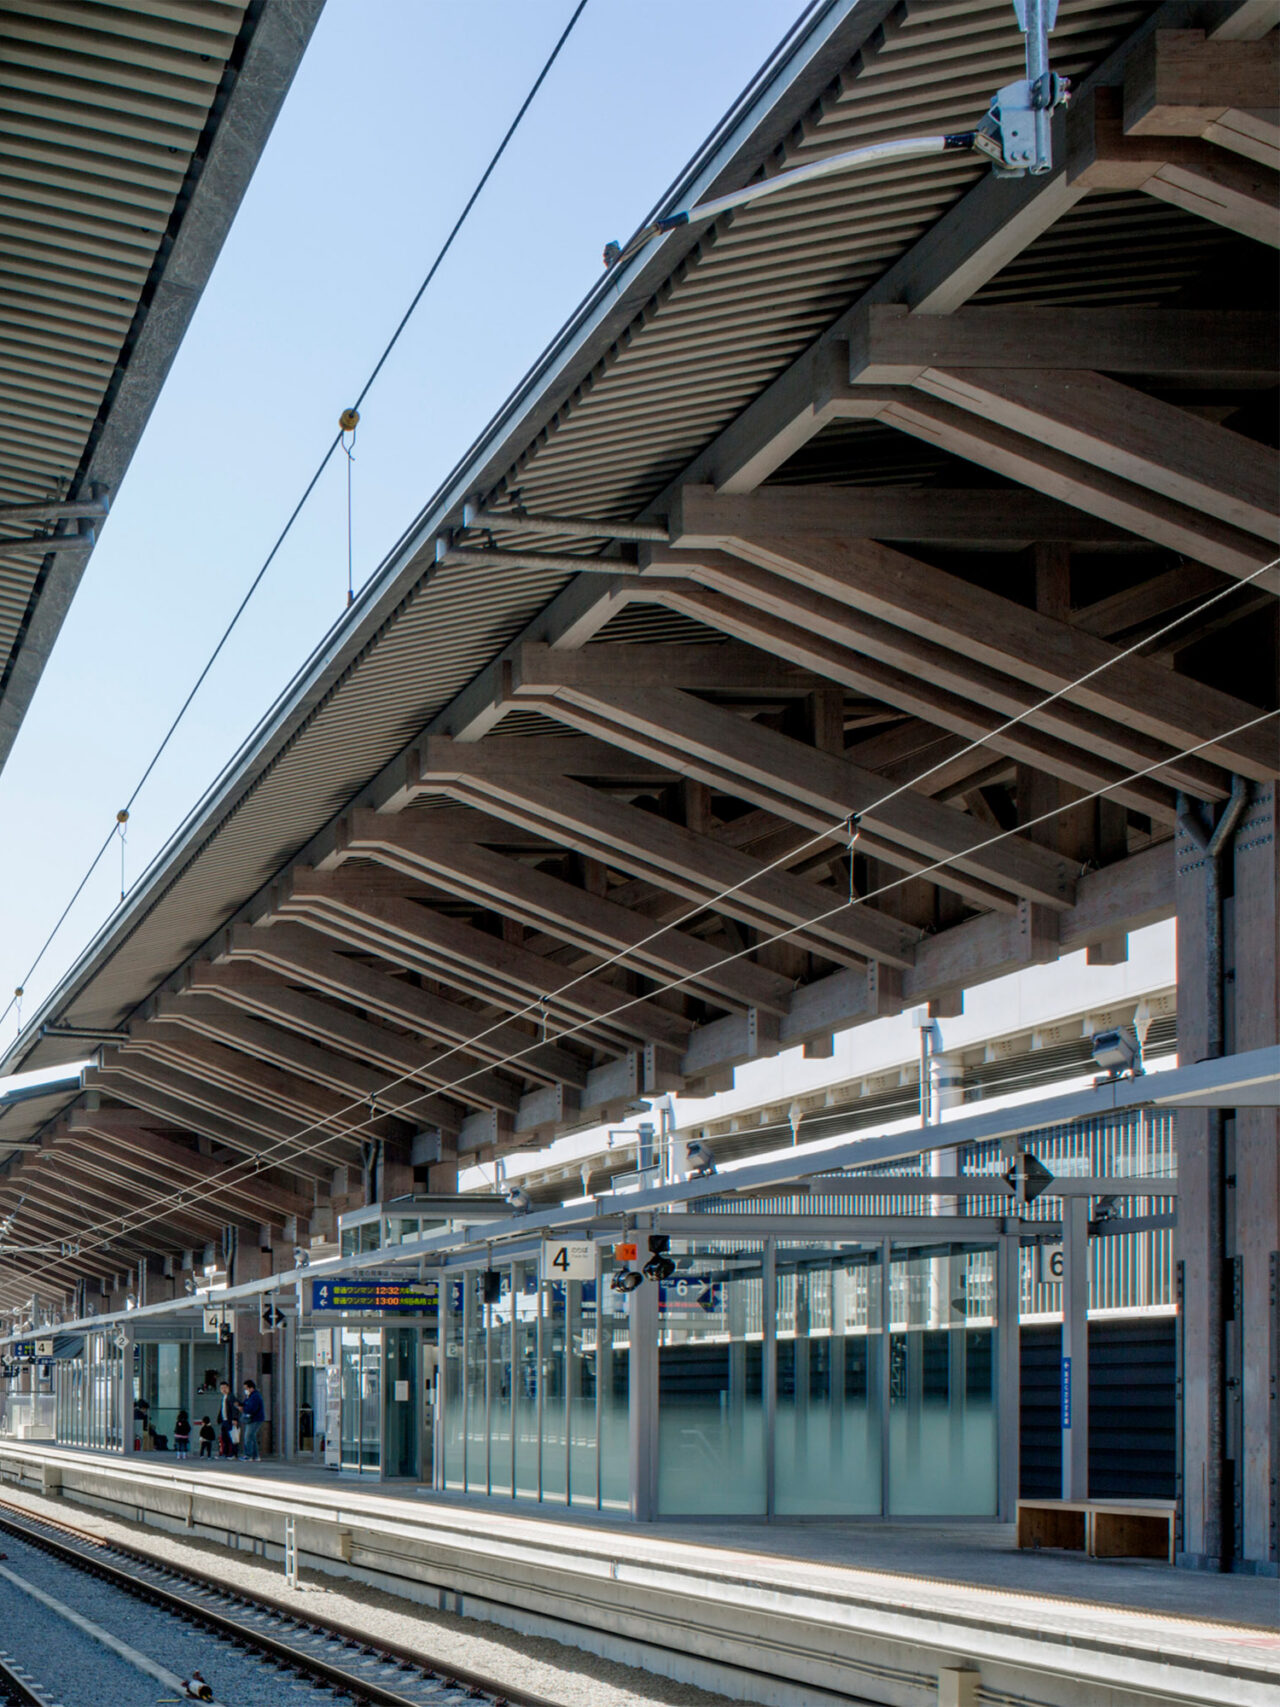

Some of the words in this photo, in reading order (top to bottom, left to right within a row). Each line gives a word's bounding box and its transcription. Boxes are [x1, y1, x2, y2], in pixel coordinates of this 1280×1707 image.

[553, 1247, 570, 1272] 4
[1050, 1252, 1063, 1276] 6
[319, 1286, 328, 1298] 4
[376, 1287, 399, 1295] 12:32
[676, 1279, 688, 1296] 6
[376, 1297, 399, 1305] 13:00
[209, 1314, 218, 1328] 4
[38, 1343, 45, 1352] 4
[118, 1337, 125, 1346] 2
